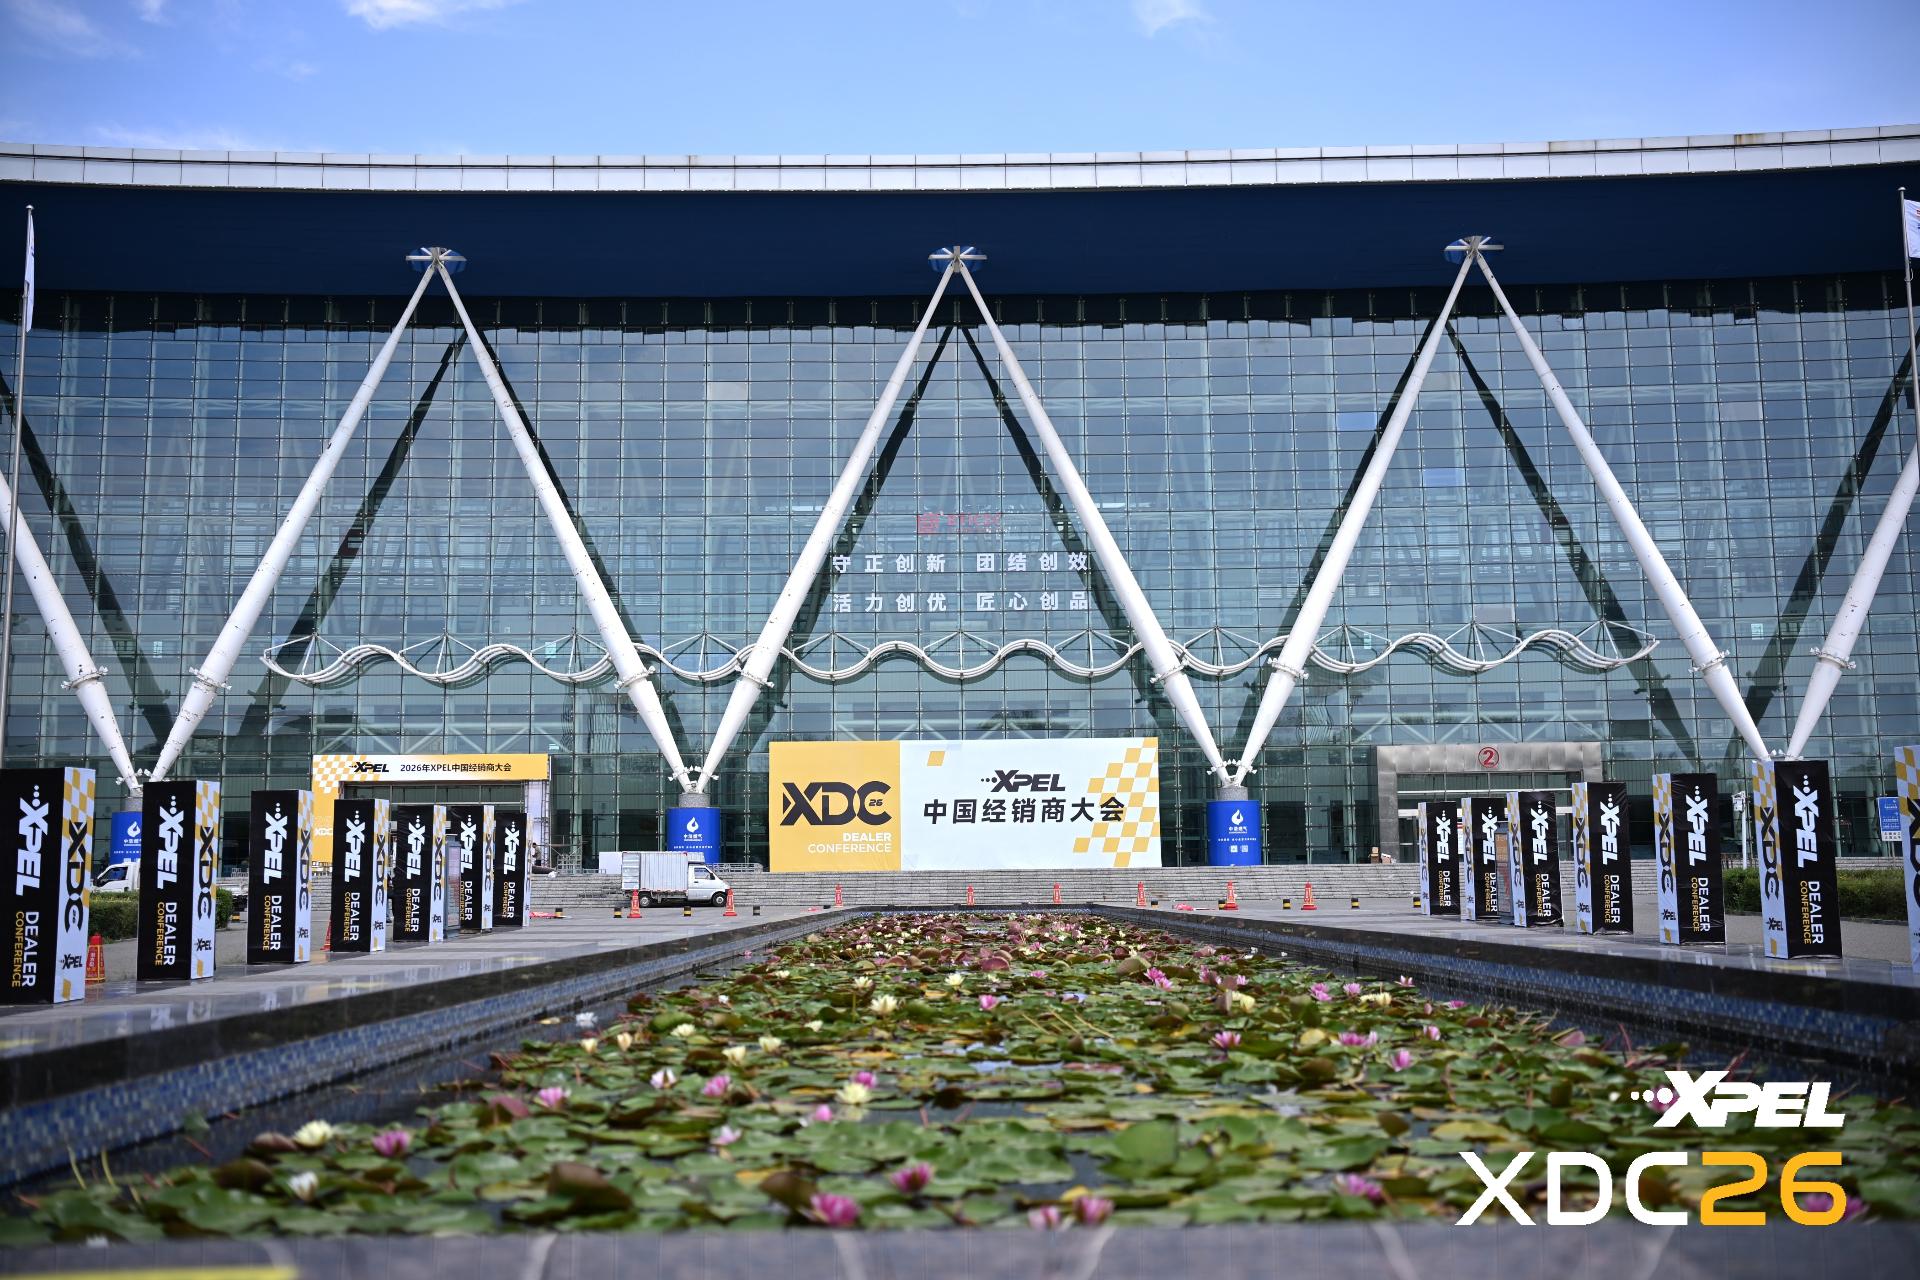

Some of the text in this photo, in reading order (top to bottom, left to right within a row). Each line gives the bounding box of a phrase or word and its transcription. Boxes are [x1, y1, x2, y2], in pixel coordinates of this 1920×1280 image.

[832, 552, 1088, 573] 守正创新 团结创效
[833, 592, 1088, 612] 活力创优 匠心创品
[354, 762, 389, 772] XPEL
[400, 763, 512, 772] 2026年XPEL中国经销商大会
[990, 770, 1065, 792] XPEL
[1483, 750, 1494, 765] 2
[780, 781, 892, 826] XDC
[869, 798, 883, 806] 26
[923, 796, 1125, 825] 中国经销商大会
[1793, 785, 1819, 868] XPEL
[16, 797, 49, 896] XPEL
[157, 806, 184, 889] XPEL
[264, 812, 288, 884] XPEL
[344, 818, 365, 882] XPEL
[407, 822, 425, 879] XPEL
[461, 821, 476, 873] XPEL
[504, 827, 519, 874] XPEL
[808, 843, 891, 853] CONFERENCE
[843, 832, 892, 842] DEALER
[1436, 816, 1450, 863] XPEL
[1482, 813, 1497, 864] XPEL
[1531, 808, 1548, 865] XPEL
[1600, 802, 1620, 864] XPEL
[1658, 813, 1673, 894] XDC
[1686, 794, 1708, 866] XPEL
[1761, 807, 1779, 900] XDC
[65, 822, 87, 933] XDC
[198, 827, 214, 920] XDC
[1442, 870, 1451, 907] DEALER
[1541, 874, 1551, 917] DEALER
[270, 896, 282, 950] DEALER
[349, 892, 360, 941] DEALER
[404, 888, 412, 932] CONFERENCE
[410, 888, 420, 932] DEALER
[507, 882, 515, 918] DEALER
[1610, 875, 1620, 924] DEALER
[1691, 877, 1700, 932] CONFERENCE
[1698, 877, 1710, 932] DEALER
[1768, 917, 1783, 931] XPEL
[1800, 881, 1812, 944] CONFERENCE
[1808, 881, 1823, 944] DEALER
[12, 912, 24, 987] CONFERENCE
[22, 912, 39, 987] DEALER
[155, 902, 164, 966] CONFERENCE
[164, 902, 177, 965] DEALER
[196, 938, 212, 951] XPEL
[61, 955, 82, 969] XPEL
